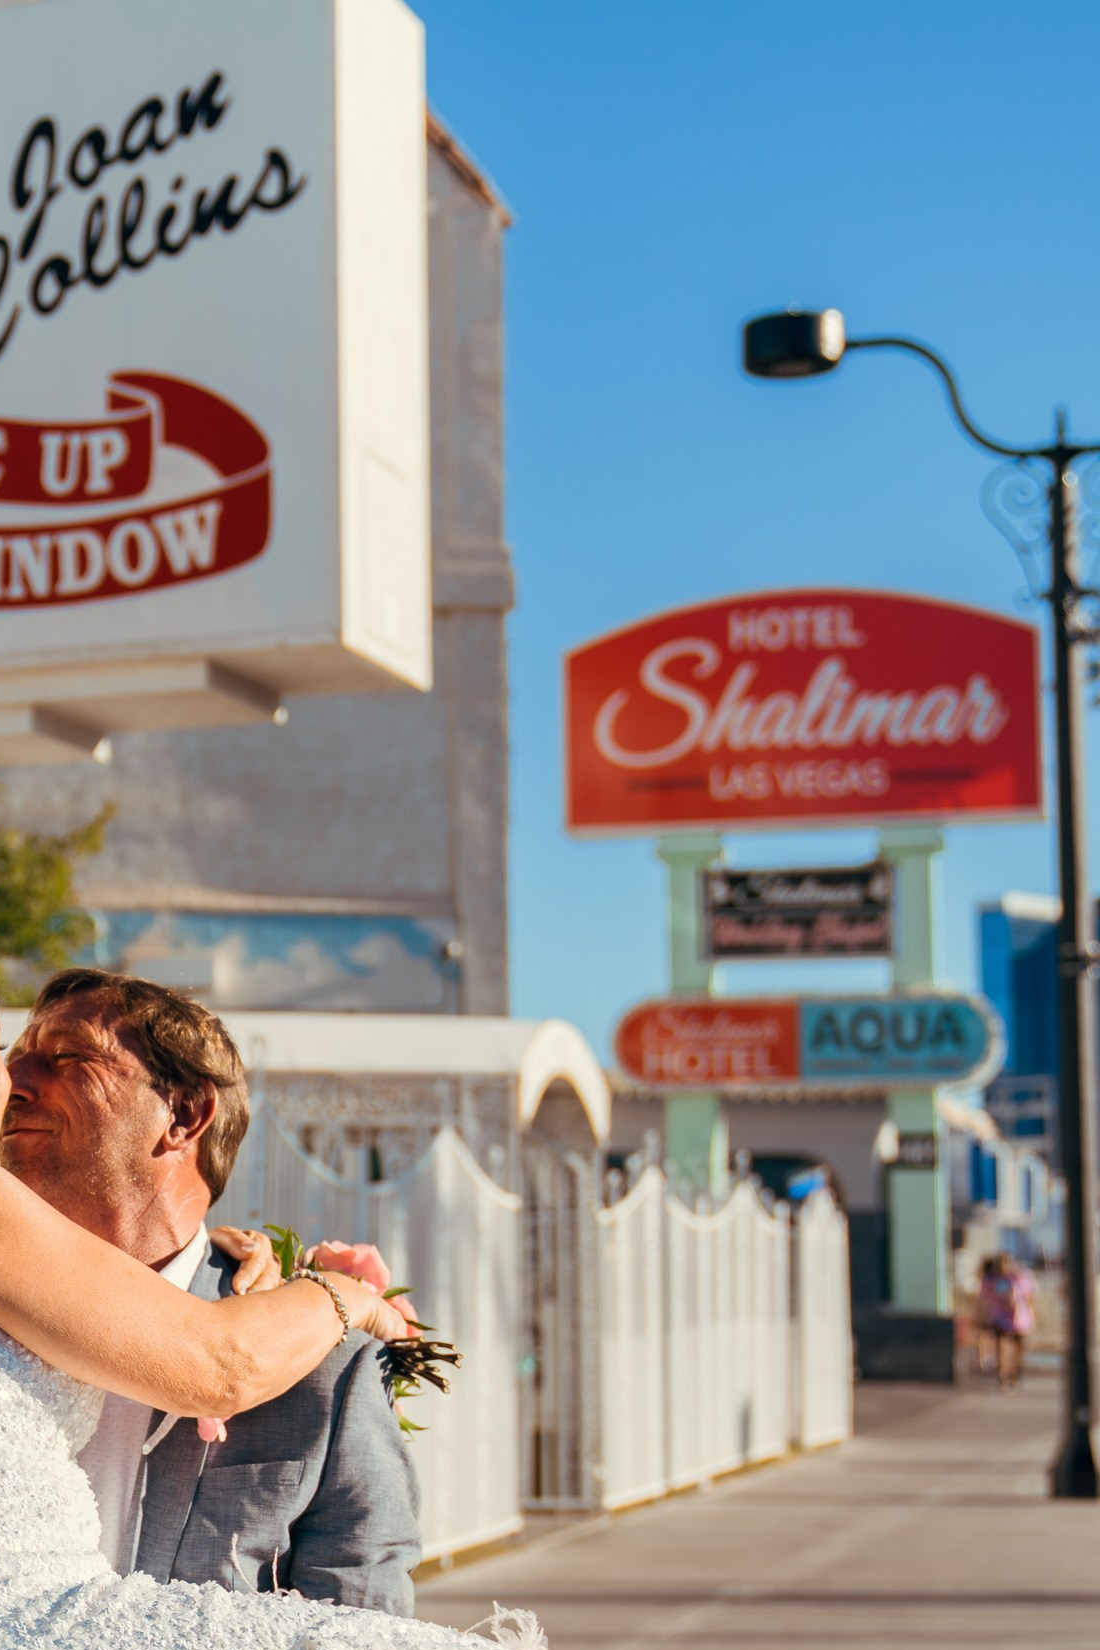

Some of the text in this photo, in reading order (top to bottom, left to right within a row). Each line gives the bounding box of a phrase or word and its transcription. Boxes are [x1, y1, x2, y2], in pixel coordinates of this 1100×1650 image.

[11, 69, 232, 261] Joan
[39, 425, 131, 499] UP
[727, 606, 865, 652] HOTEL
[593, 636, 1009, 768] Shalimar
[708, 757, 892, 801] LAS VEGAS
[810, 1006, 966, 1054] AQUA
[642, 1040, 780, 1079] HOTEL
